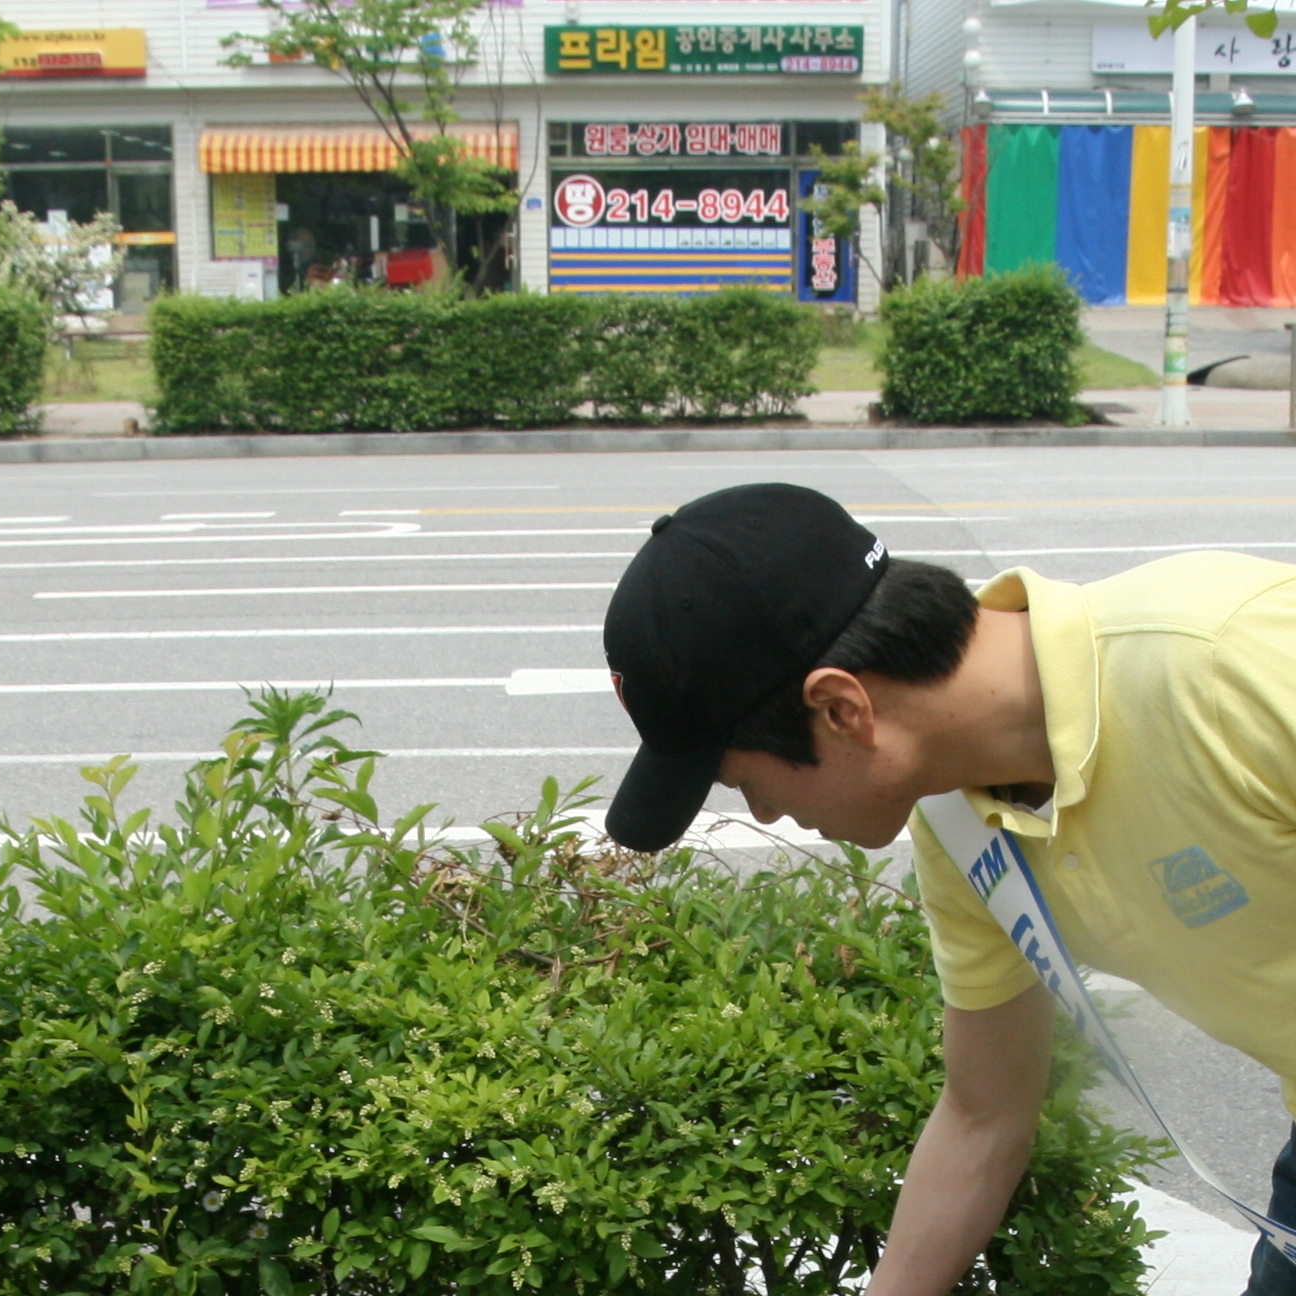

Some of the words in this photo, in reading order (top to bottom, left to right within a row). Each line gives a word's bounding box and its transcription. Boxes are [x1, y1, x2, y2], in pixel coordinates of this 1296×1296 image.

[558, 29, 666, 69] 프라임
[789, 26, 856, 51] 사무소
[606, 188, 790, 223] 214-8944
